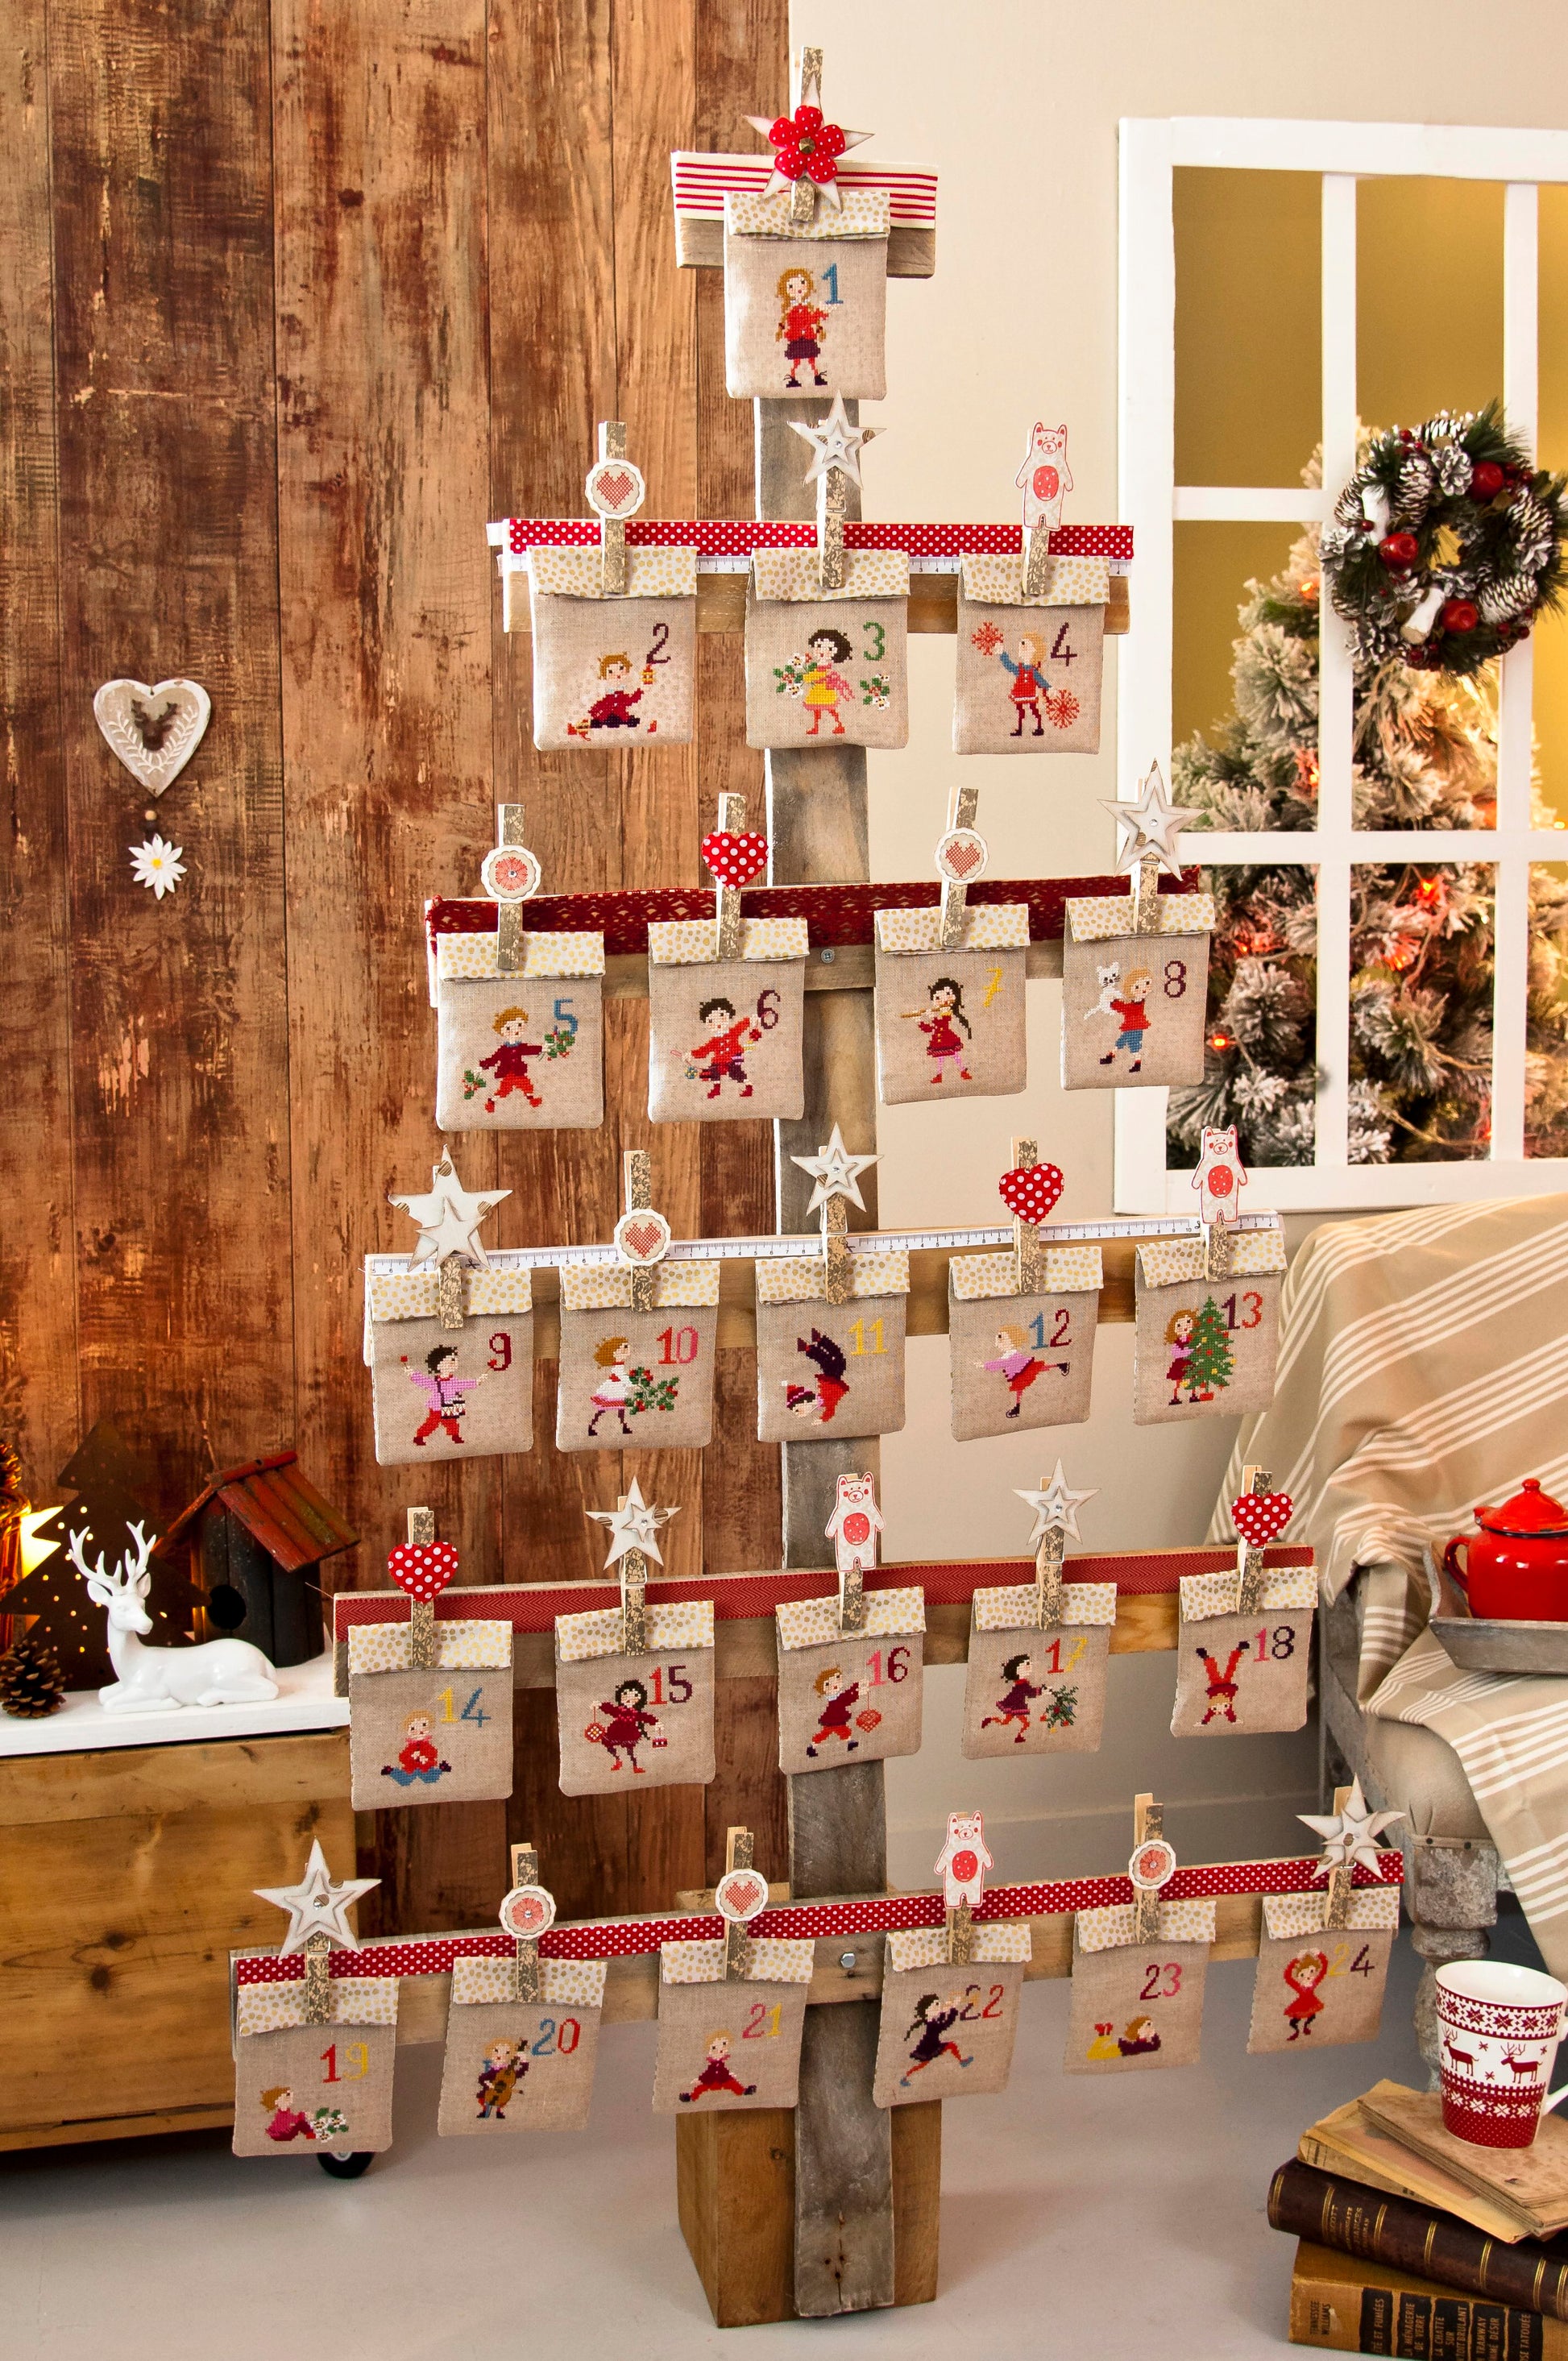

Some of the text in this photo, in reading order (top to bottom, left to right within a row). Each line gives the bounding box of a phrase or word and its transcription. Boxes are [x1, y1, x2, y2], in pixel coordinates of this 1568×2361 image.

[820, 263, 844, 305] 1
[646, 623, 671, 665] 2
[863, 621, 886, 661] 3
[1050, 622, 1077, 667] 4
[982, 967, 1004, 1007] 7
[1164, 960, 1187, 998] 8
[554, 998, 579, 1036] 5
[757, 990, 781, 1029] 6
[1028, 1308, 1072, 1350] 12
[1222, 1291, 1263, 1330] 13
[487, 1332, 512, 1371] 9
[656, 1326, 699, 1364] 10
[848, 1317, 889, 1355] 11
[1045, 1637, 1089, 1674] 17
[1253, 1625, 1296, 1662] 18
[649, 1665, 693, 1704] 15
[866, 1646, 911, 1687] 16
[437, 1686, 492, 1728] 14
[1329, 1943, 1375, 1977] 24
[1139, 1962, 1182, 2001] 23
[741, 2002, 782, 2039] 21
[960, 1984, 1004, 2021] 22
[531, 2018, 581, 2056] 20
[320, 2042, 369, 2083] 19
[1310, 2301, 1319, 2334] TENNESSEE
[1321, 2303, 1330, 2334] WILLIAMS
[1373, 2298, 1384, 2328] FUMÉES
[1414, 2313, 1425, 2351] DE VERRE
[1487, 2317, 1500, 2340] DÉSIR
[1519, 2313, 1530, 2348] TATOUÉE
[1373, 2330, 1383, 2339] ET
[1434, 2316, 1444, 2356] LA CHATTE
[1446, 2331, 1454, 2346] SUR
[1476, 2317, 1486, 2354] TRAMWAY
